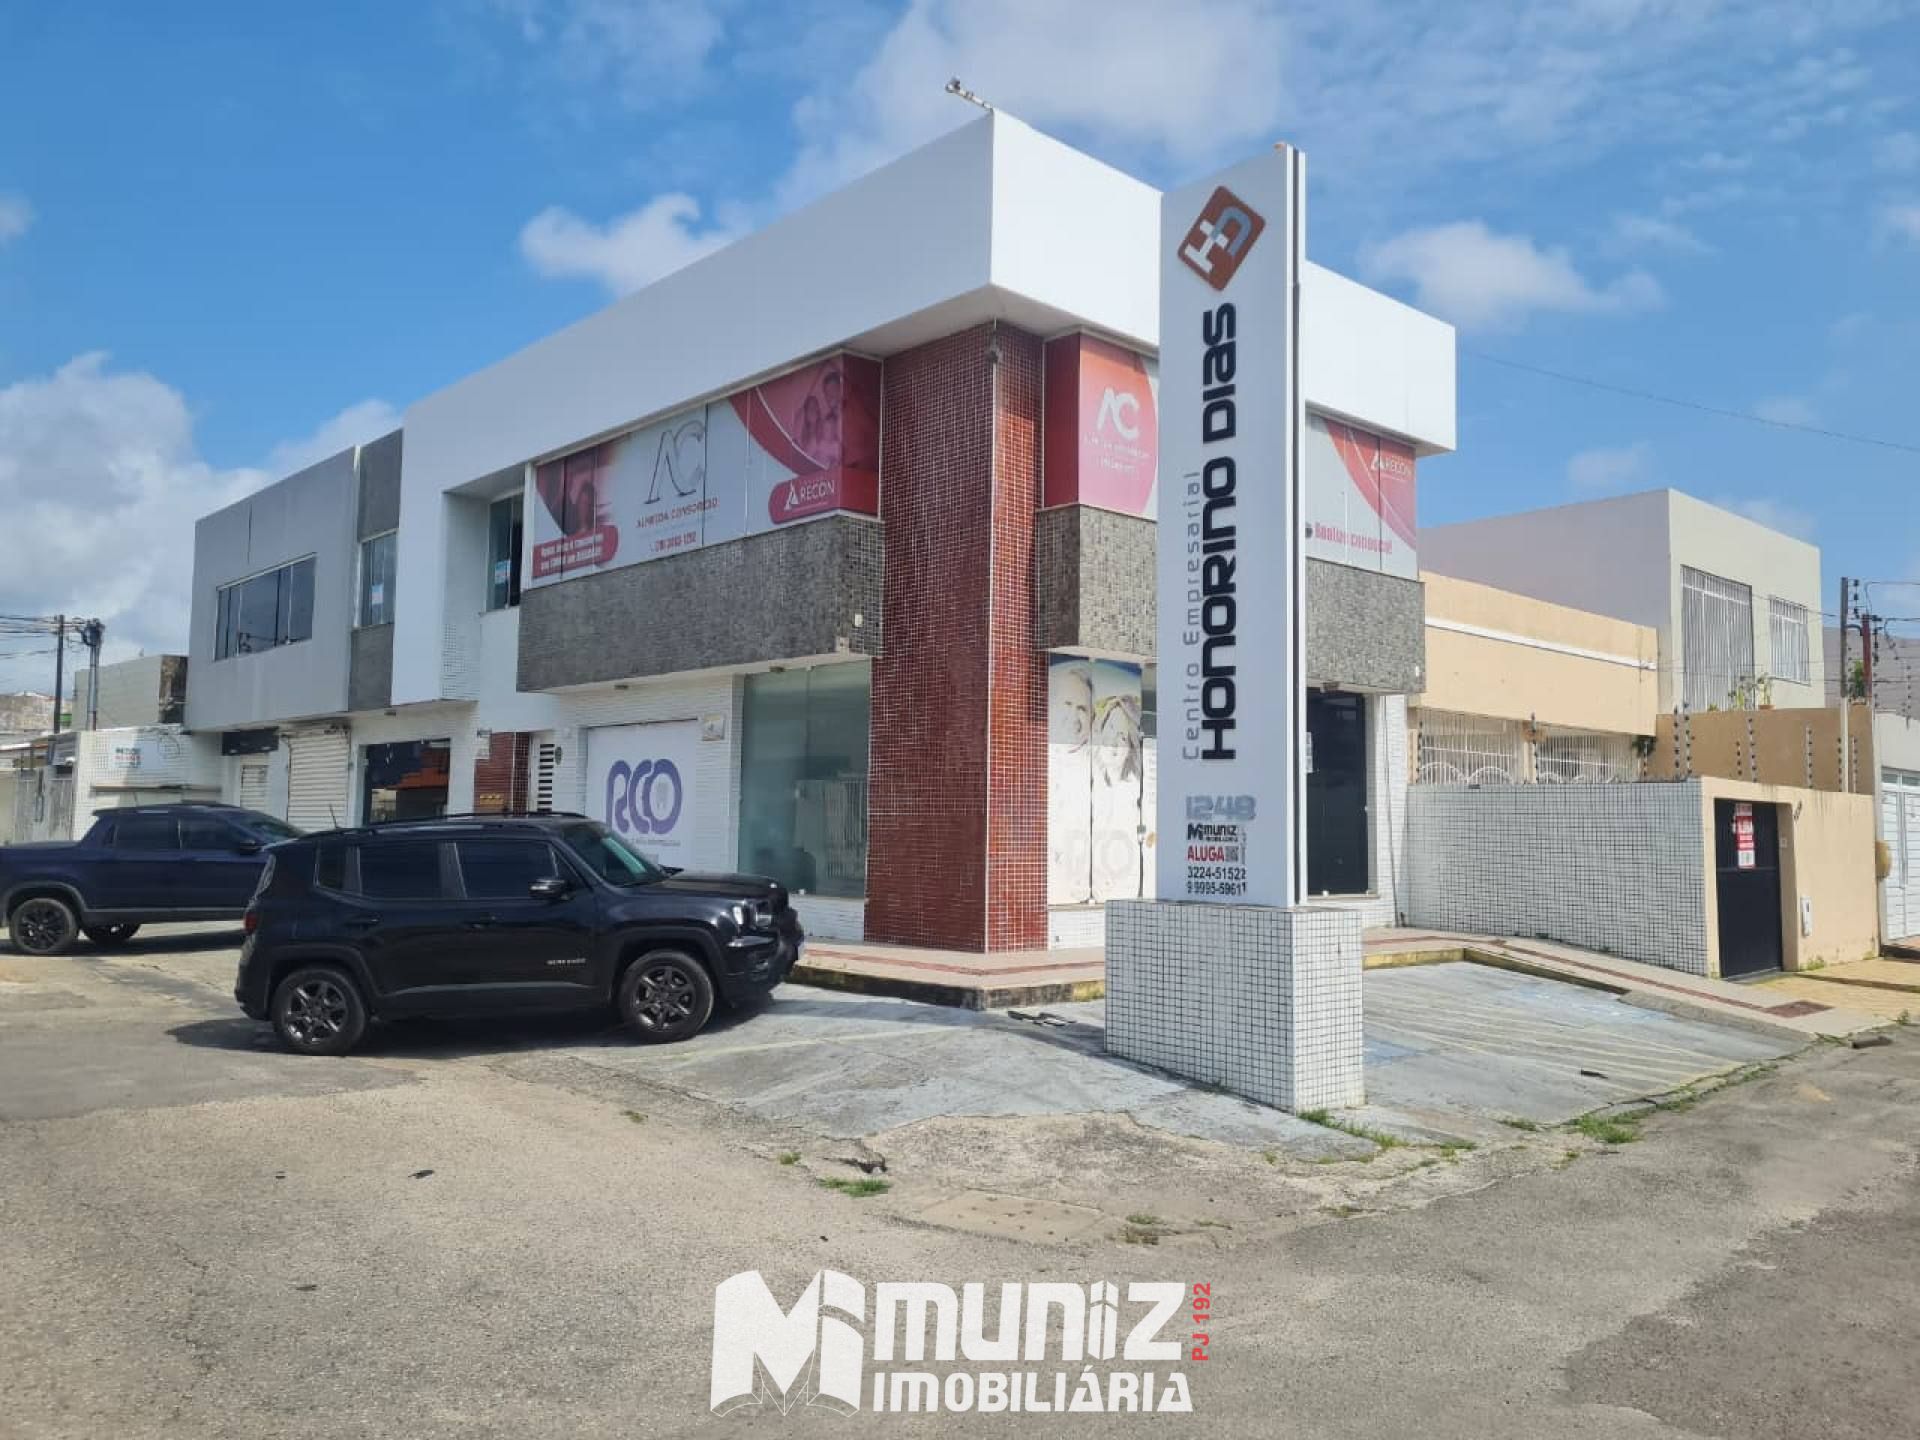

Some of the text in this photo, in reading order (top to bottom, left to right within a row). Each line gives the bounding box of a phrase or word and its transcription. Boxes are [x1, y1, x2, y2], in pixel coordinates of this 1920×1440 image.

[1183, 471, 1203, 760] Centro Empresarial
[1187, 846, 1225, 861] ALUGA
